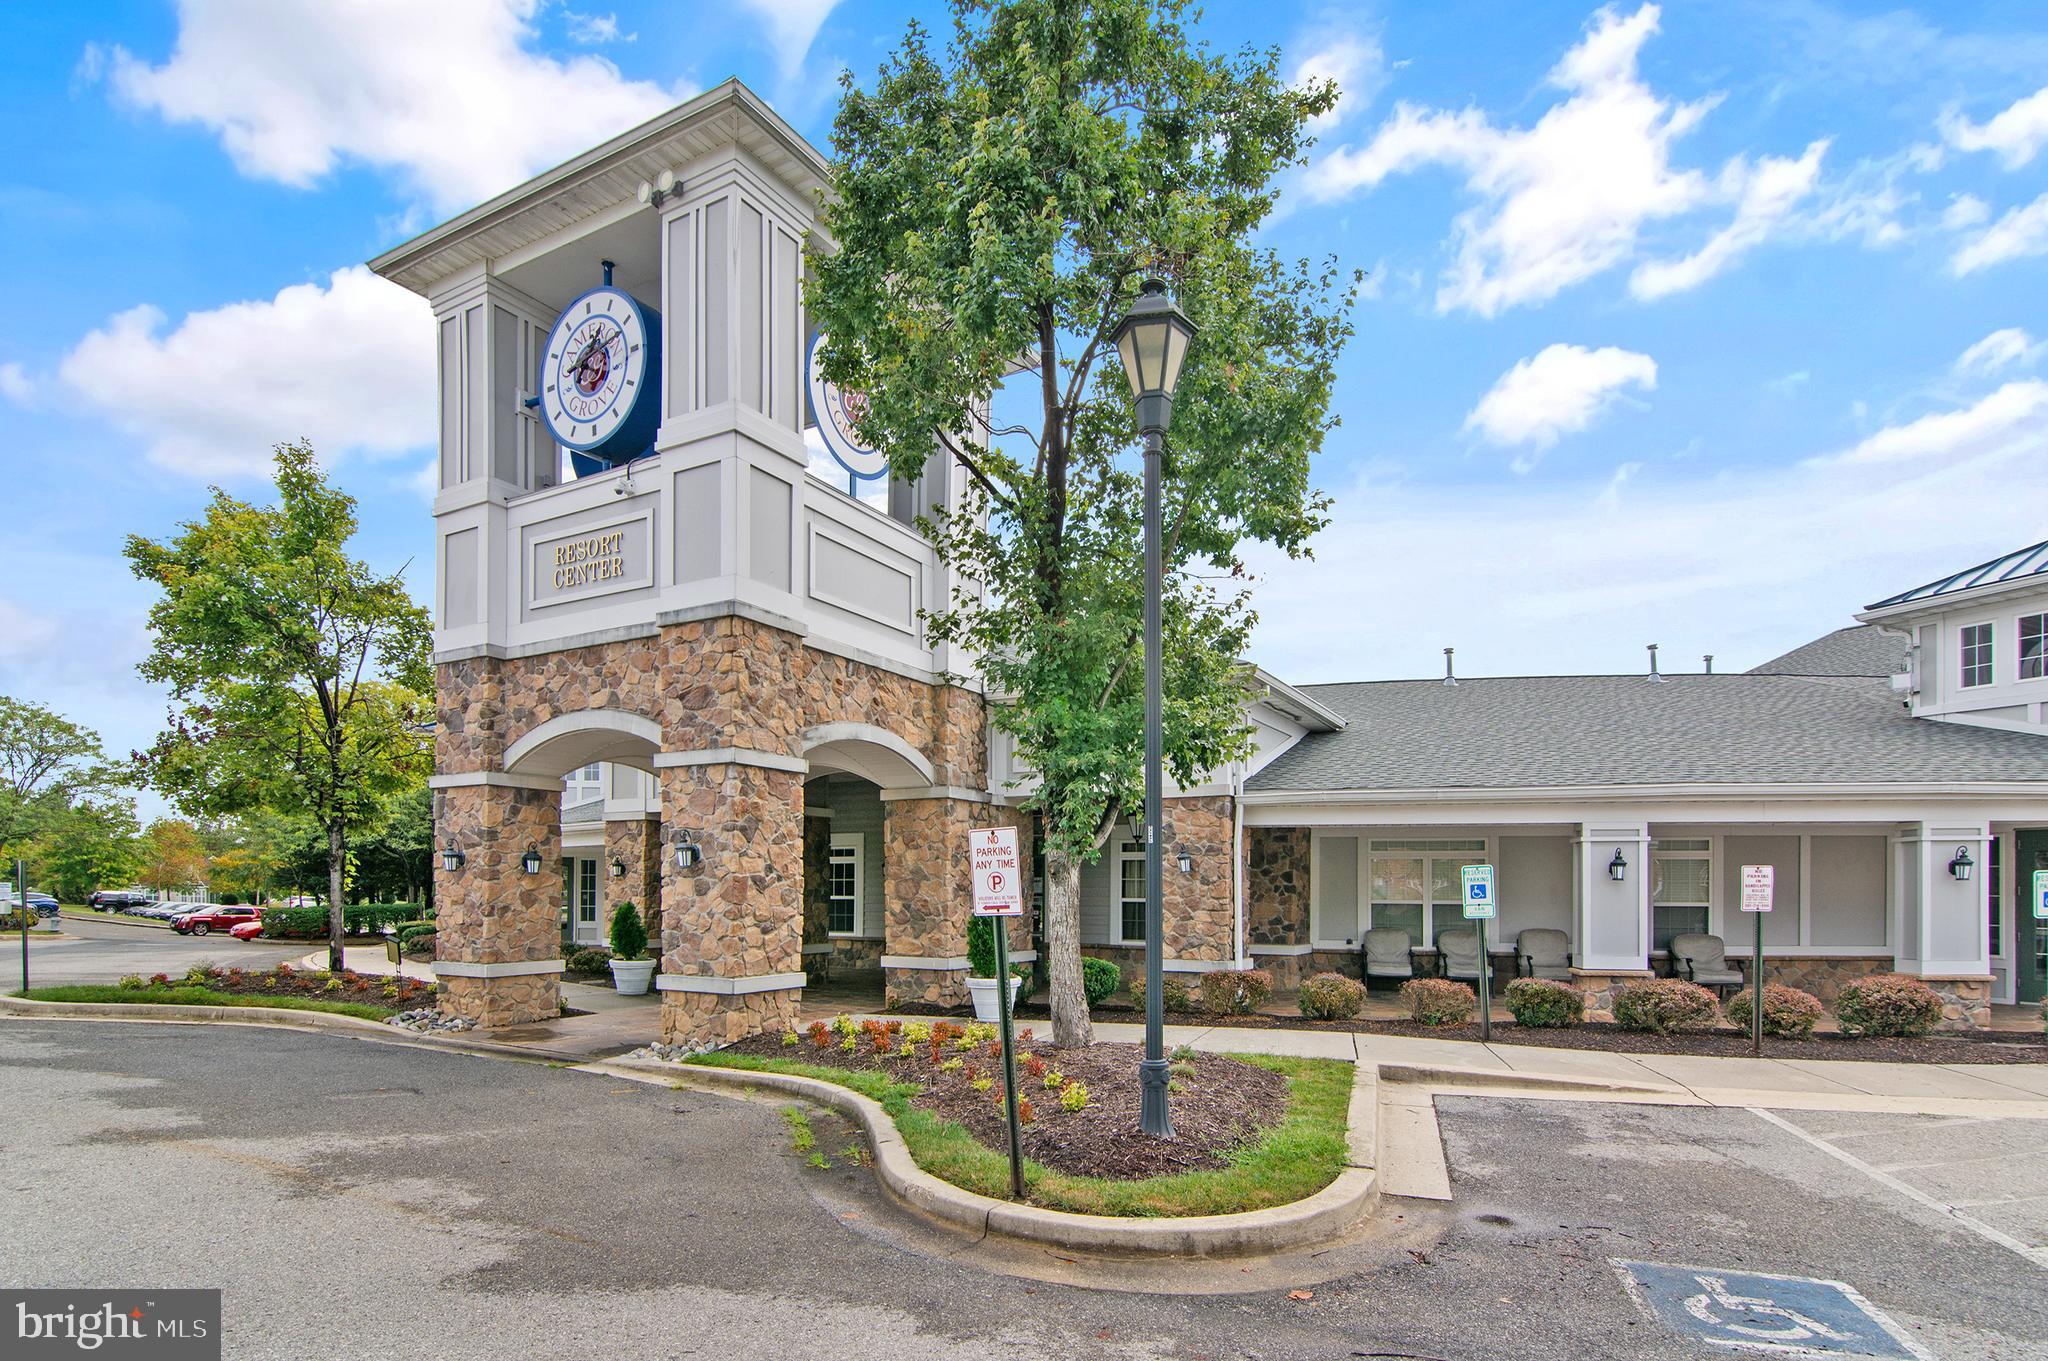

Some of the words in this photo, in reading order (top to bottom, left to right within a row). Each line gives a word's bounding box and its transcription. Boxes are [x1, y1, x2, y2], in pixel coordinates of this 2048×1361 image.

[561, 322, 623, 379] CAMERON
[569, 380, 618, 417] GROVE
[555, 532, 623, 566] RESORT
[554, 556, 623, 589] CENTER
[976, 846, 1012, 857] PARKING
[987, 835, 999, 845] NO
[975, 860, 992, 870] ANY
[996, 859, 1015, 869] TIME
